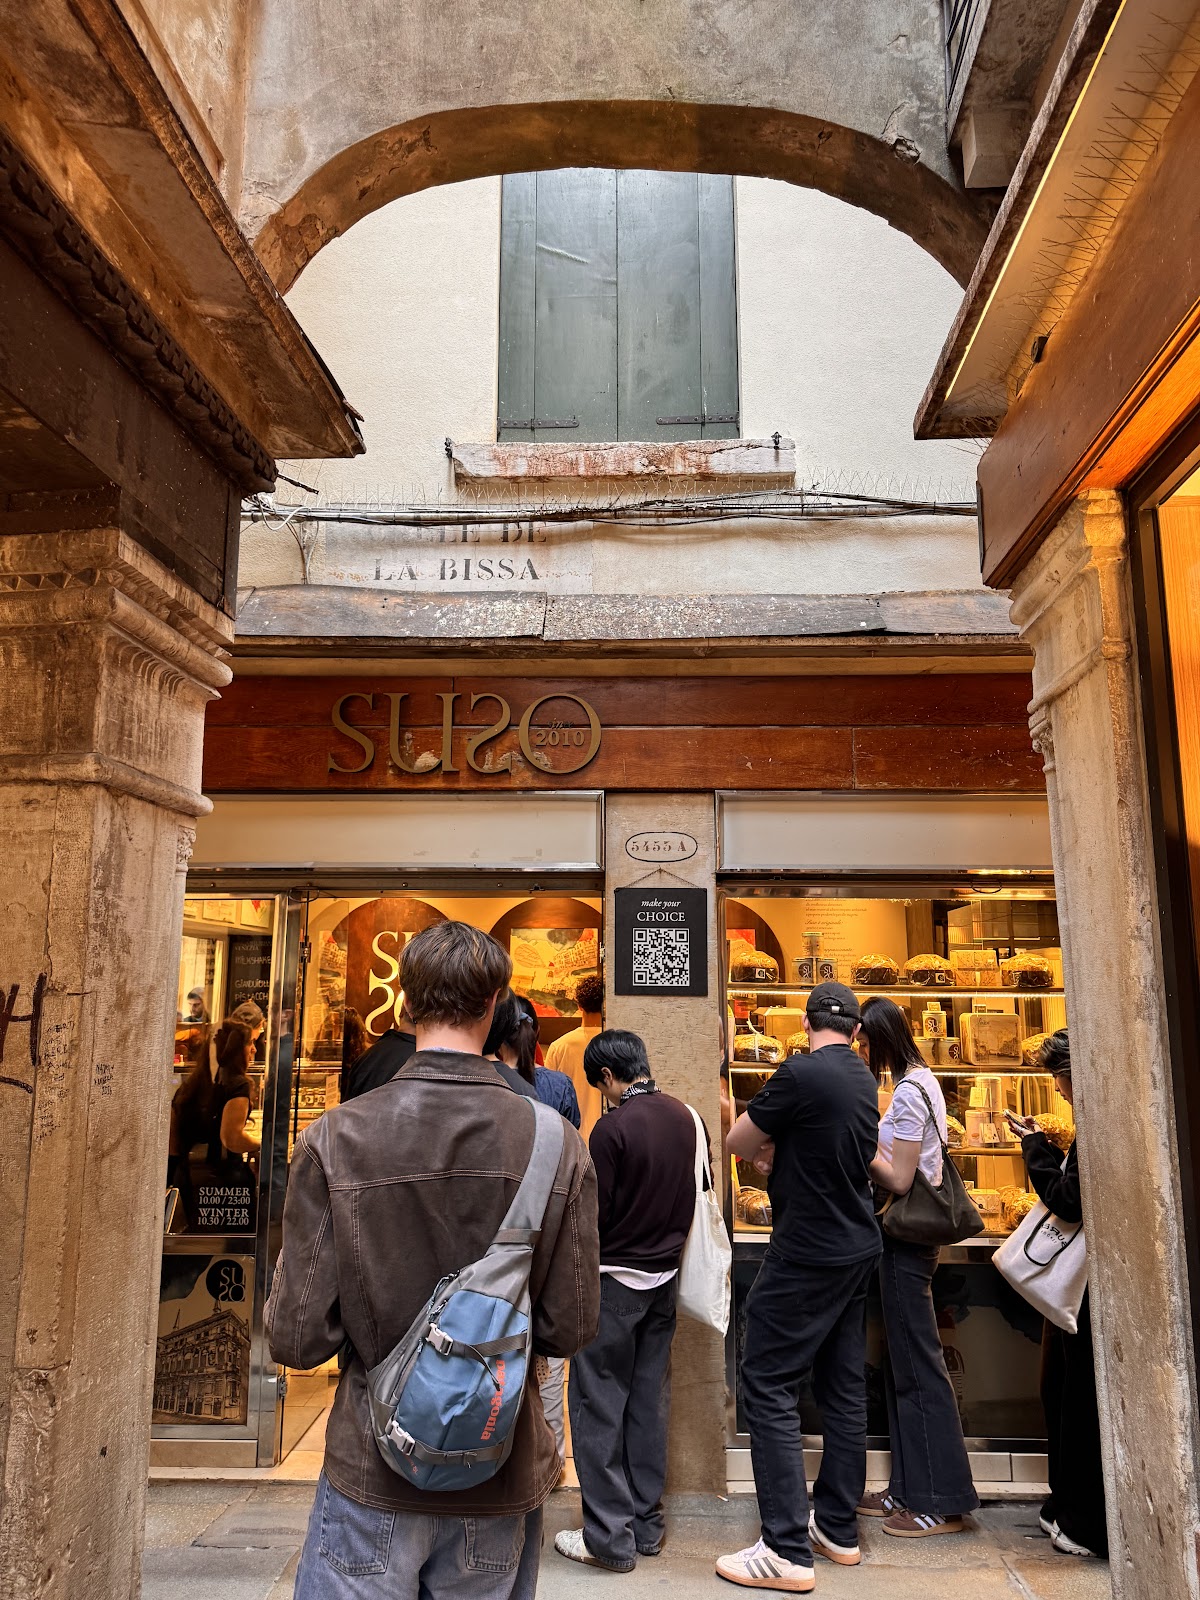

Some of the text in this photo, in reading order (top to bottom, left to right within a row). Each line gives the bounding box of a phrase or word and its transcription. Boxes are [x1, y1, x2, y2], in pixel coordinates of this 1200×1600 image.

[374, 558, 540, 581] LA BISSA
[327, 692, 602, 775] SUSO
[535, 730, 586, 747] 2010
[631, 840, 687, 852] 5455 A
[641, 898, 681, 909] make your
[636, 911, 686, 922] CHOICE
[199, 1186, 251, 1196] SUMMER
[198, 1196, 220, 1205] 10.00
[198, 1207, 250, 1218] WINTER
[197, 1216, 219, 1226] 10.30
[226, 1216, 249, 1226] 22.00
